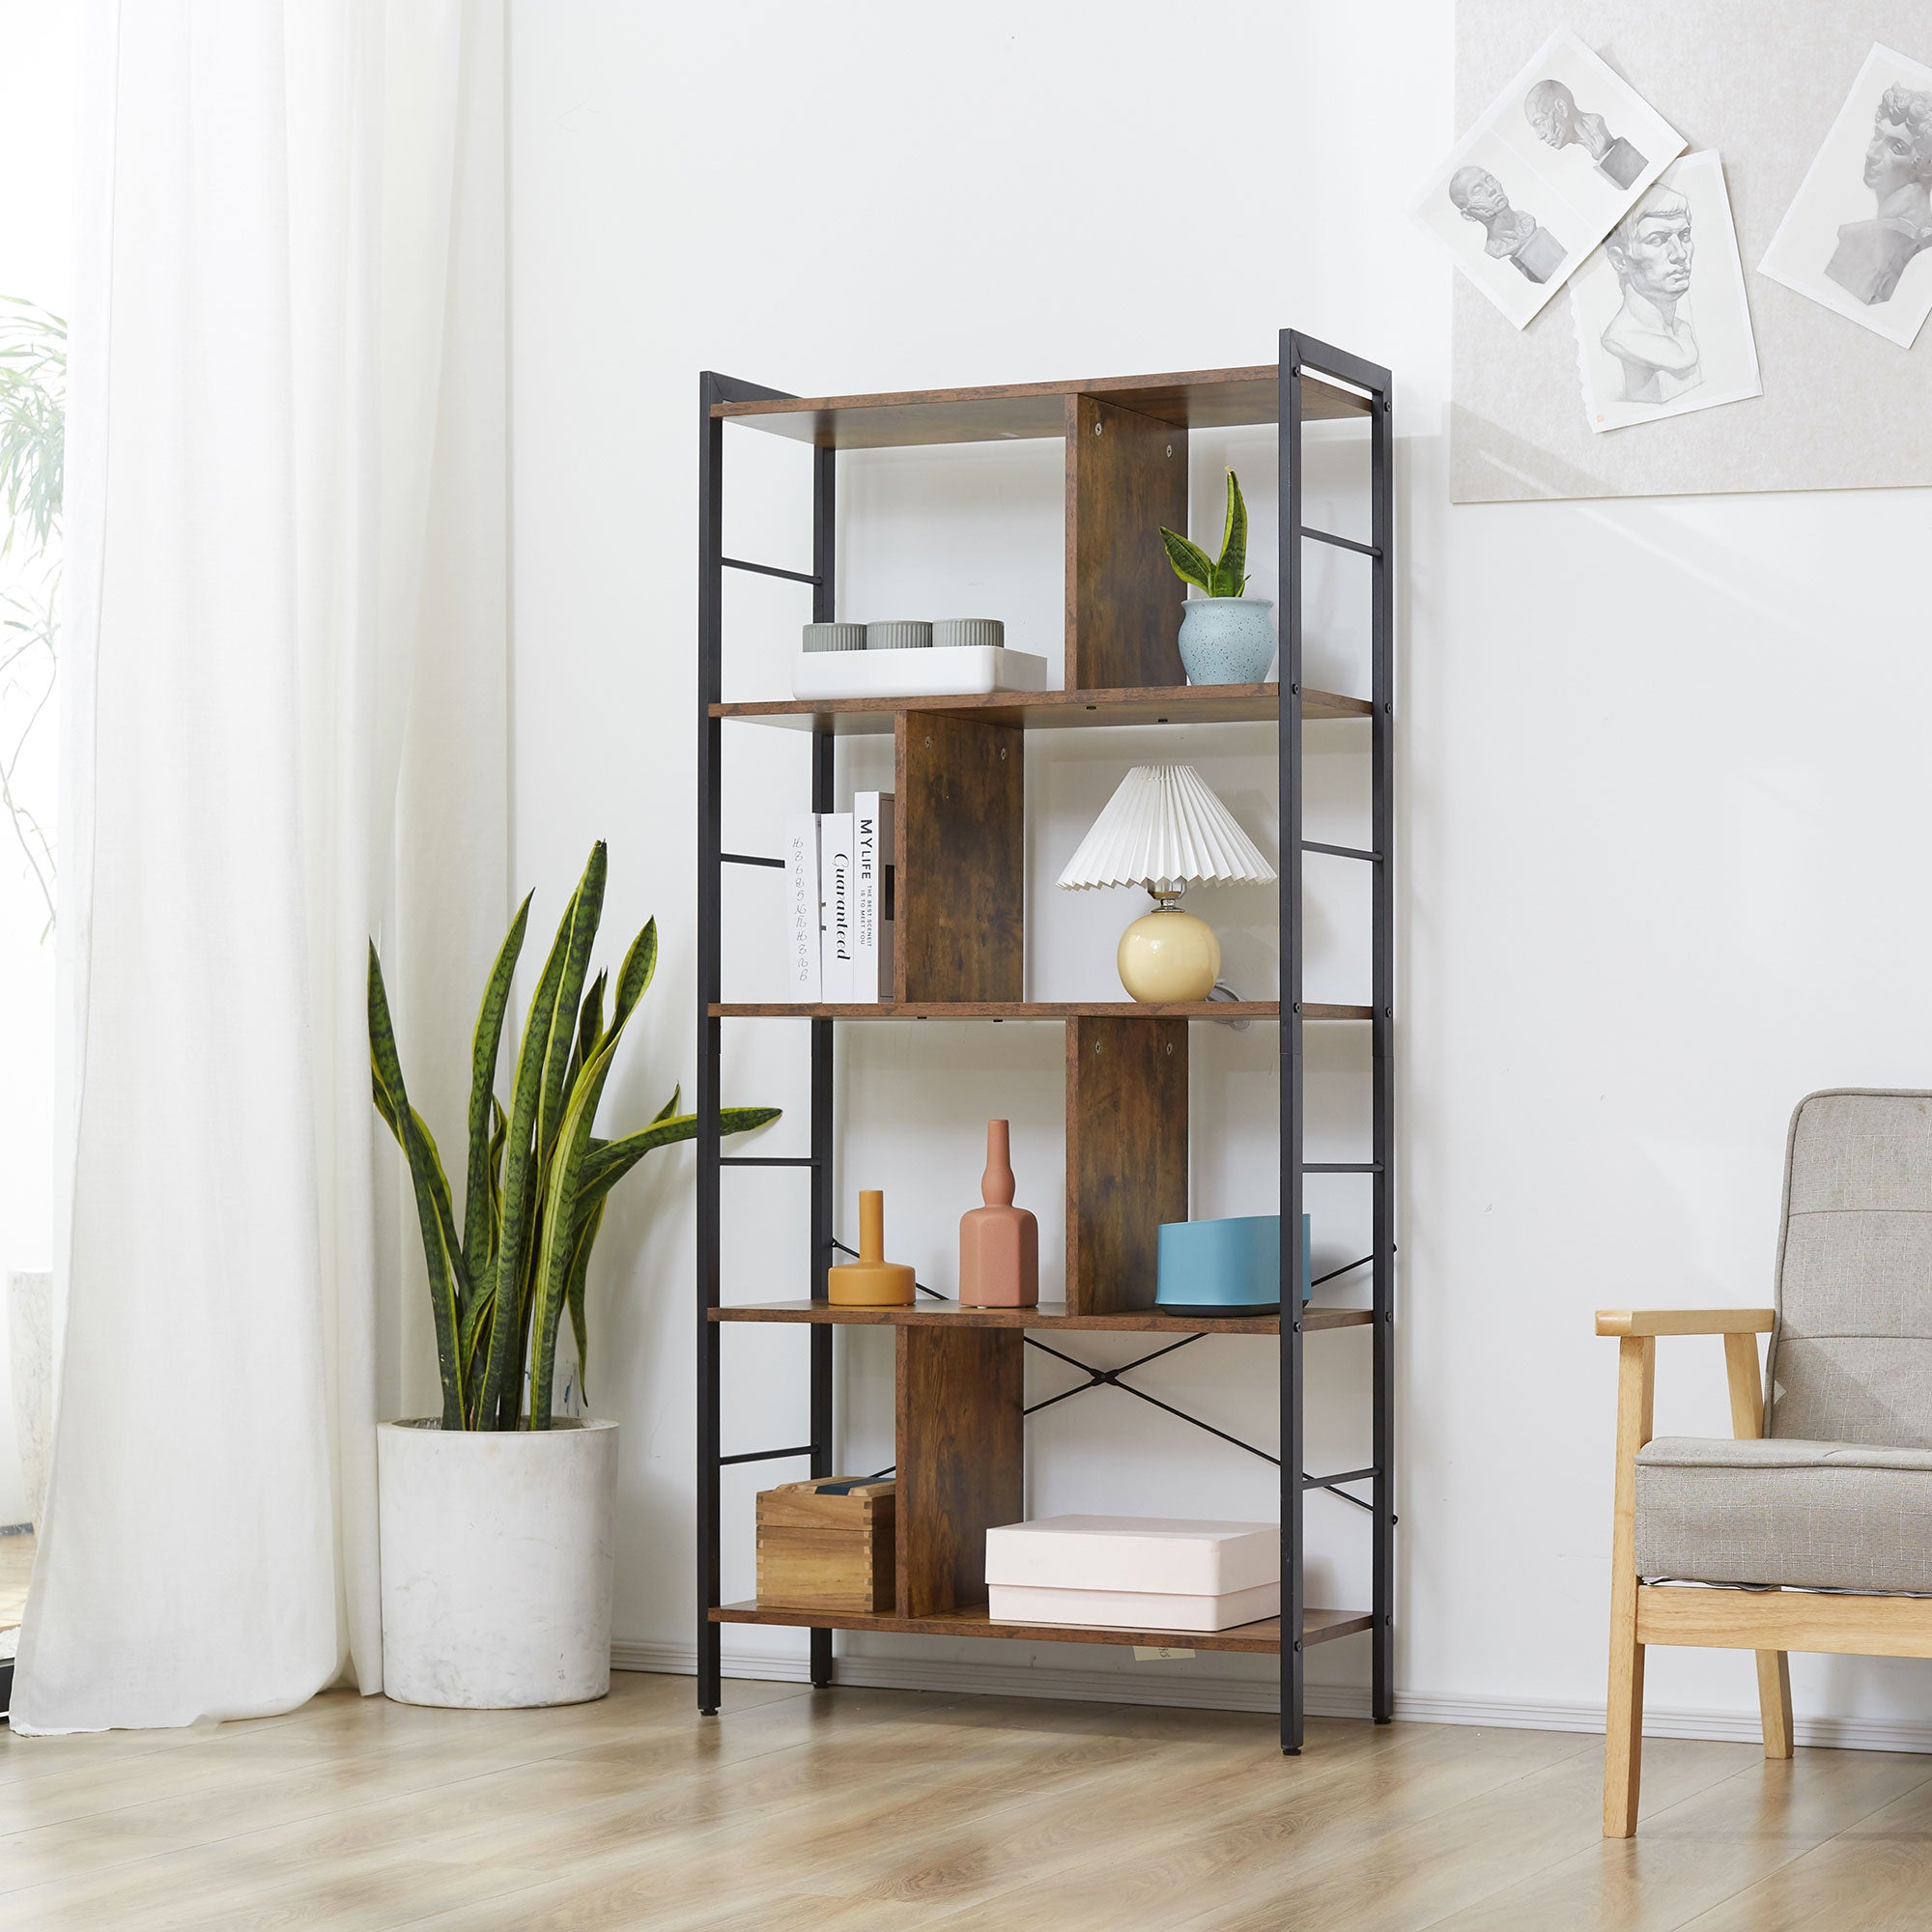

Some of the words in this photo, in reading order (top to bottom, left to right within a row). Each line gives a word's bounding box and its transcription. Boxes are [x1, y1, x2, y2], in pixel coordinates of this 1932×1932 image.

[860, 889, 867, 897] IS
[832, 853, 851, 960] Guaranteed
[860, 899, 866, 908] TO
